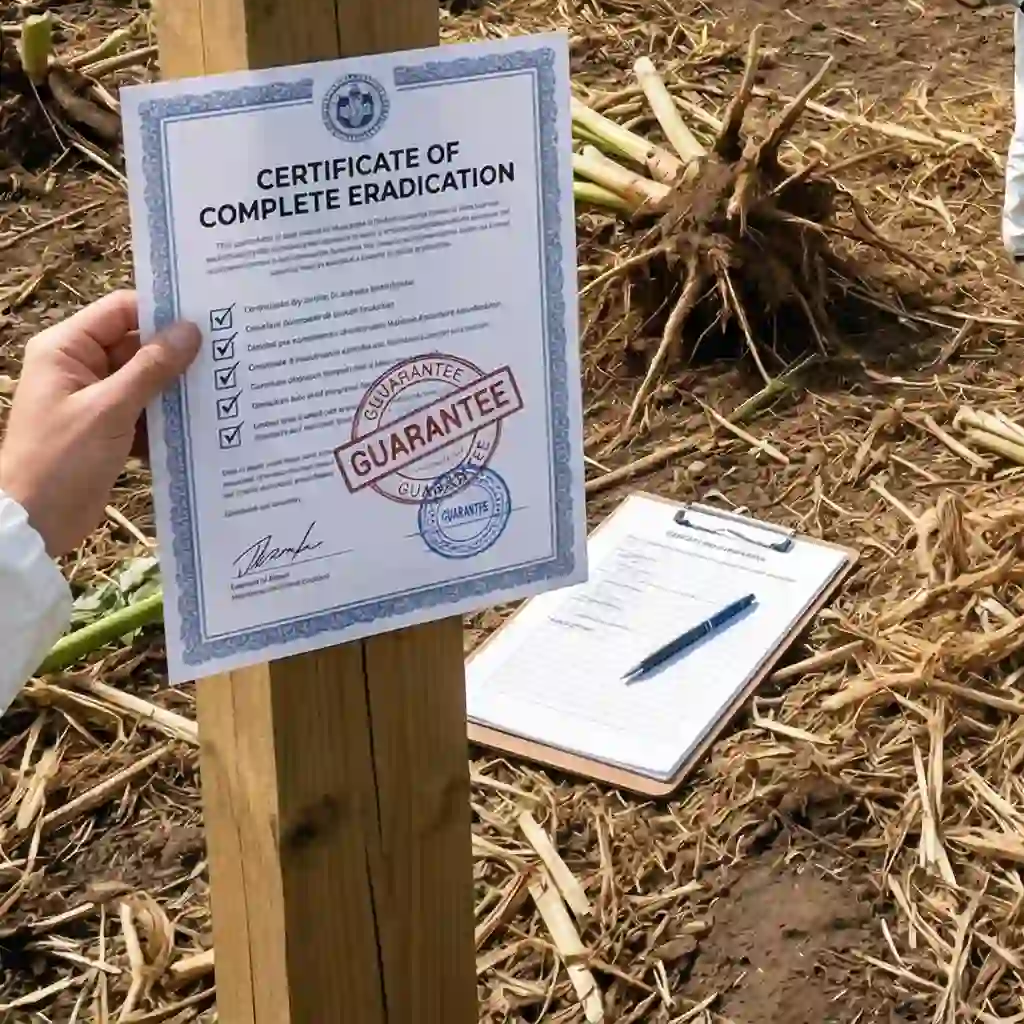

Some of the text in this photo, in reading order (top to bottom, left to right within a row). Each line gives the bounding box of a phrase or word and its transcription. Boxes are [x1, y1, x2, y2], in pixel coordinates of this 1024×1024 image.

[199, 187, 341, 228] COMPLETE
[348, 161, 516, 206] ERADICATION
[256, 141, 460, 190] CERTIFICATE OF
[350, 379, 511, 477] GUARANTEE
